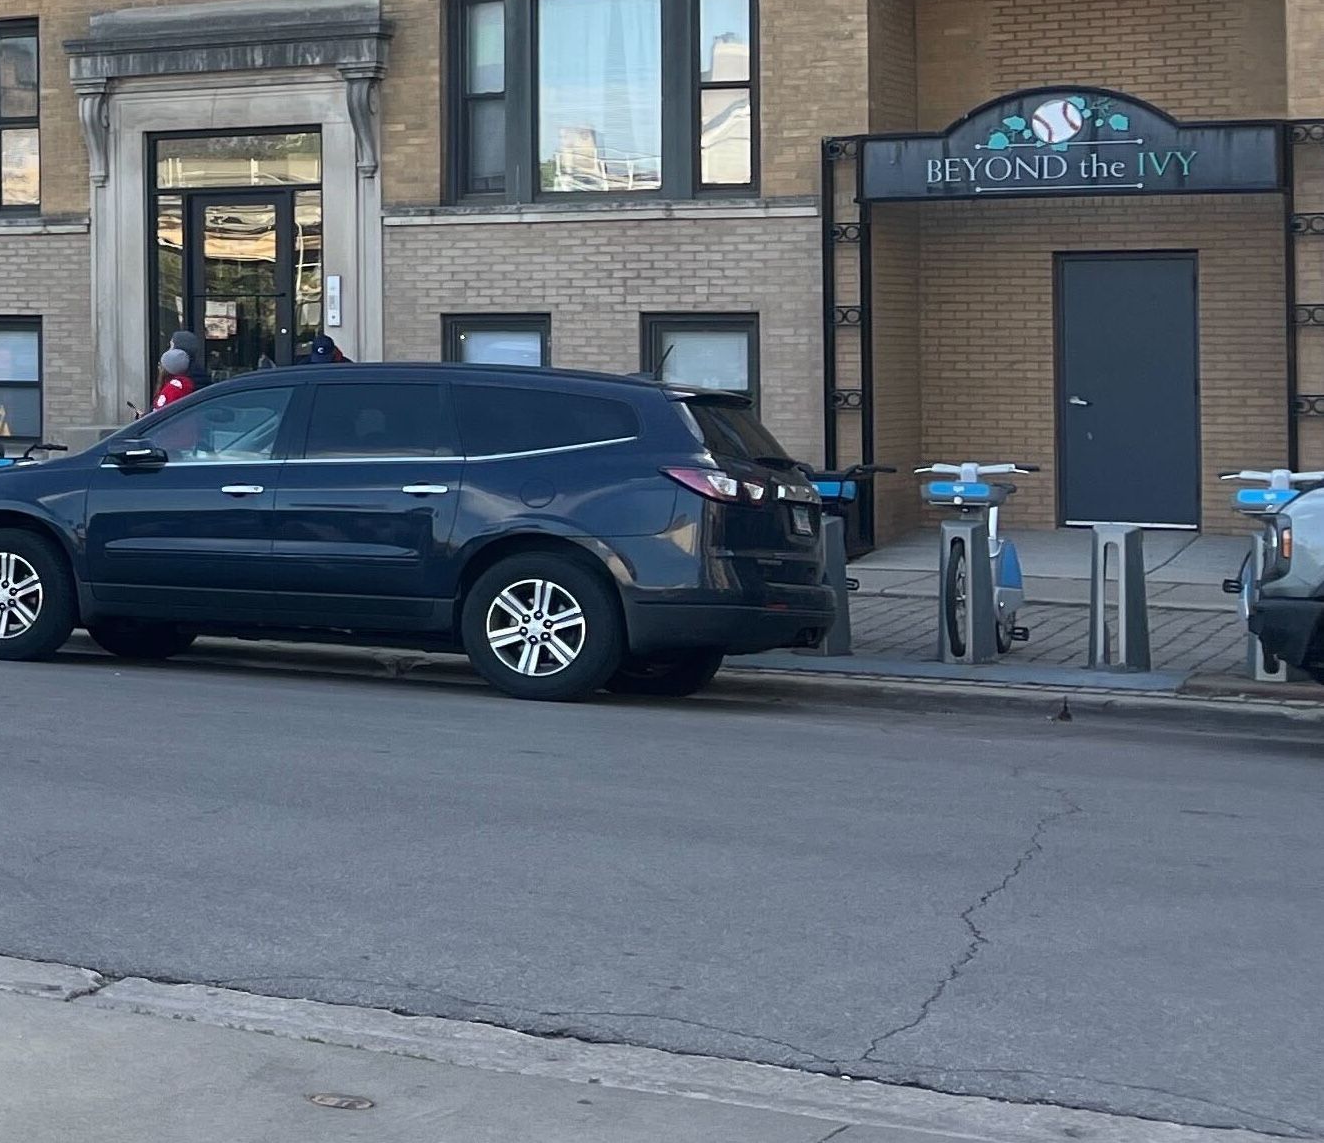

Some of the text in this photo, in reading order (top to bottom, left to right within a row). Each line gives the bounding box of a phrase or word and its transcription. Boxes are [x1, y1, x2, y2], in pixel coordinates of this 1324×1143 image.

[927, 150, 1198, 184] BEYOND the IVY
